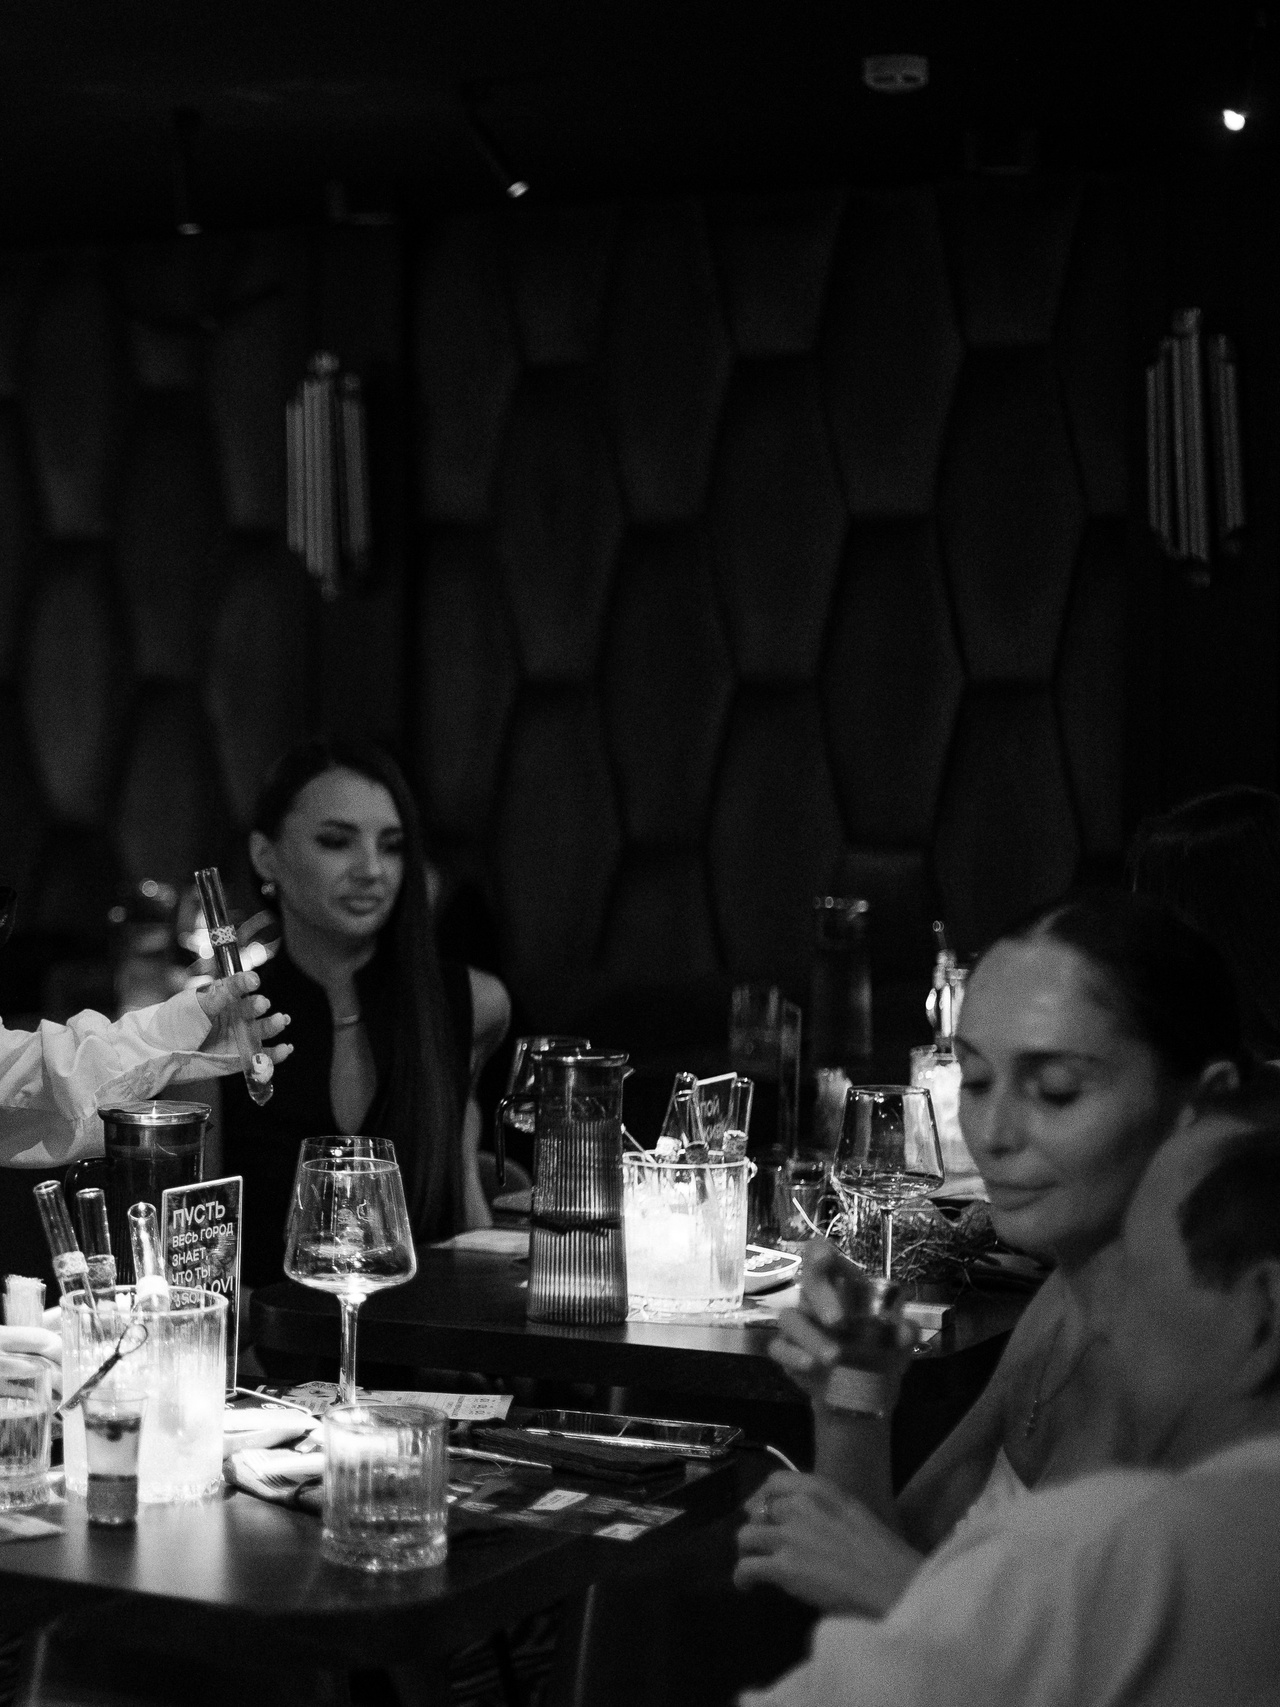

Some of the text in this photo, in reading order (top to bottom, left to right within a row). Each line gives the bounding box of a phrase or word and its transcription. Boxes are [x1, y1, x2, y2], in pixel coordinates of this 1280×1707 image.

[173, 1200, 226, 1229] ПУСТЬ
[172, 1222, 234, 1248] ВЕСЬ ГОРОД
[172, 1247, 208, 1267] ЗНАЕТ,
[172, 1264, 211, 1285] ЧТО ТЫ
